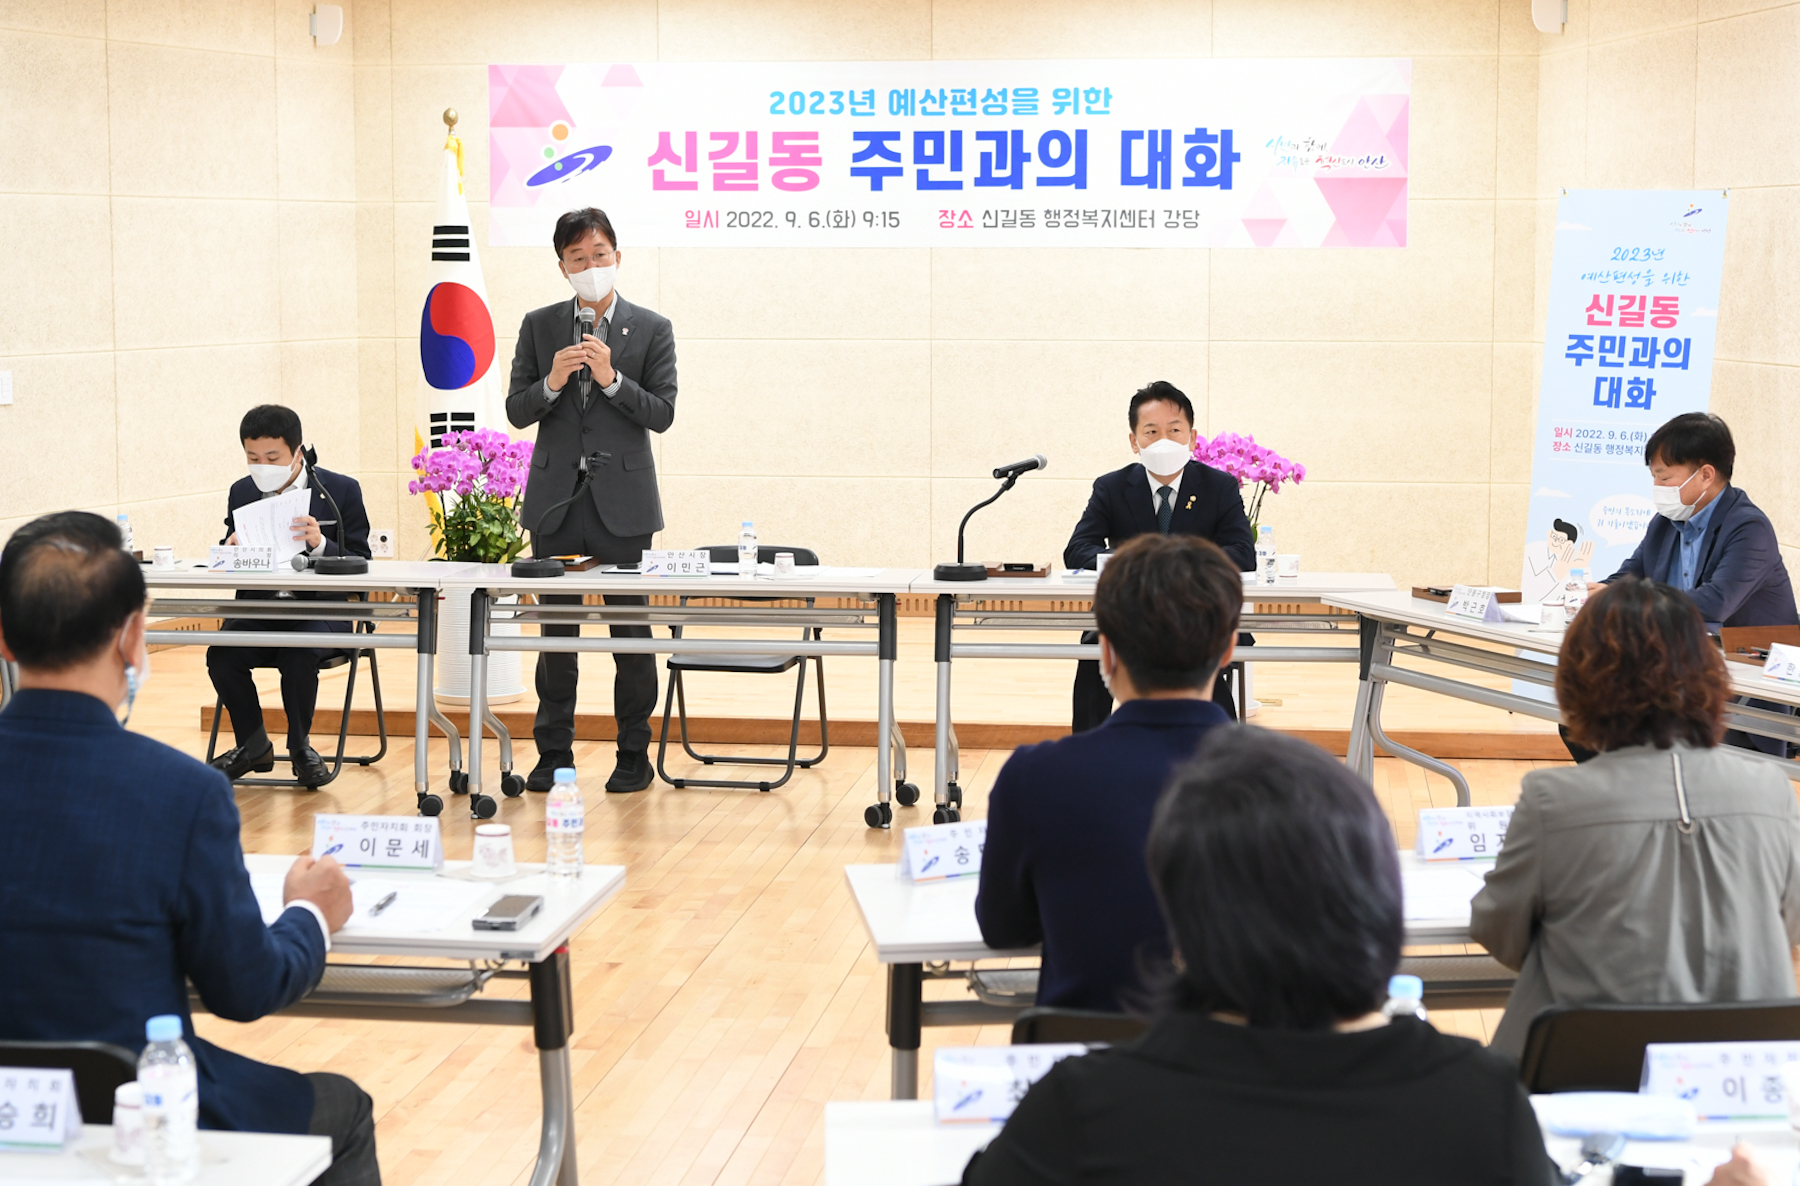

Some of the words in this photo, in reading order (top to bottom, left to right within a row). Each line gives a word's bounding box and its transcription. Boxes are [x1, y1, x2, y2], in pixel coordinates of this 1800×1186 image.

[769, 88, 876, 117] 2023년
[888, 87, 1040, 118] 예산편성을
[1051, 86, 1113, 116] 위한
[647, 130, 823, 192] 신길동
[850, 128, 1088, 192] 주민과의
[1120, 127, 1241, 190] 대화
[684, 210, 719, 228] 일시
[726, 211, 779, 228] 2022.
[785, 211, 801, 228] 9.
[808, 210, 856, 229] 6.(화)
[862, 211, 900, 228] 9:15
[938, 210, 974, 229] 장소
[982, 210, 1036, 228] 신길동
[1043, 209, 1155, 229] 행정복지센터
[1163, 210, 1200, 229] 강당
[1610, 246, 1666, 262] 2023년
[1581, 268, 1655, 288] 예산편성을
[1661, 270, 1691, 287] 위한
[1585, 294, 1680, 329] 신길동
[1565, 334, 1692, 370] 주민과의
[1593, 376, 1657, 410] 대화
[1554, 427, 1573, 438] 일시
[1575, 428, 1605, 440] 2022.
[1608, 430, 1617, 440] 9.
[1552, 441, 1572, 452] 장소
[1574, 442, 1602, 454] 신길동
[1605, 443, 1645, 456] 행정복지
[233, 558, 271, 569] 송바우나
[666, 562, 705, 573] 이민근
[359, 837, 430, 859] 이문세
